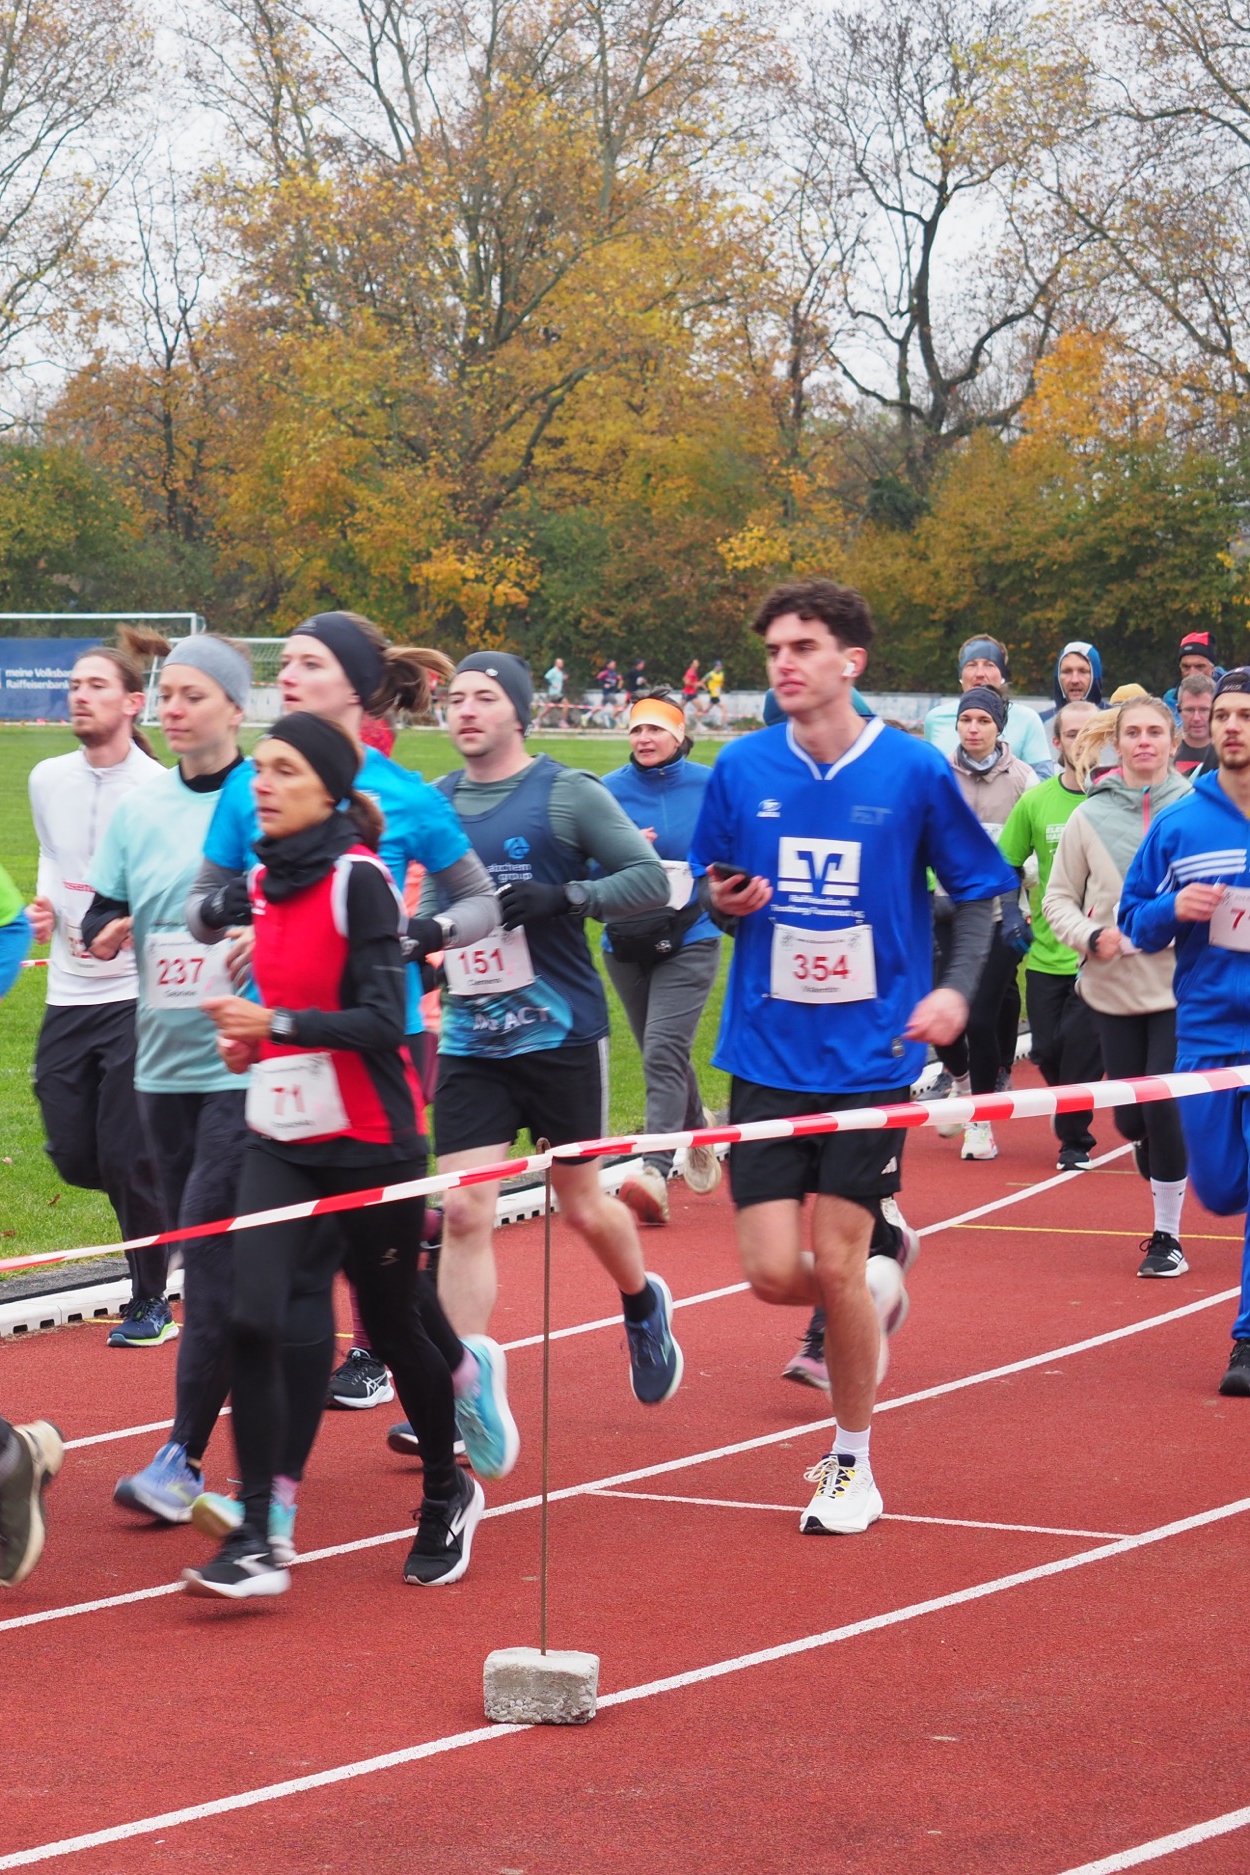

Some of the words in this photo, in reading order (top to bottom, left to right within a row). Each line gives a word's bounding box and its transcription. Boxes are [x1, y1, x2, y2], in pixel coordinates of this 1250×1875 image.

[5, 668, 33, 677] meine
[34, 667, 72, 678] Volksban
[157, 957, 205, 985] 237
[459, 947, 504, 975] 151
[793, 953, 851, 981] 354
[270, 1084, 306, 1116] 71
